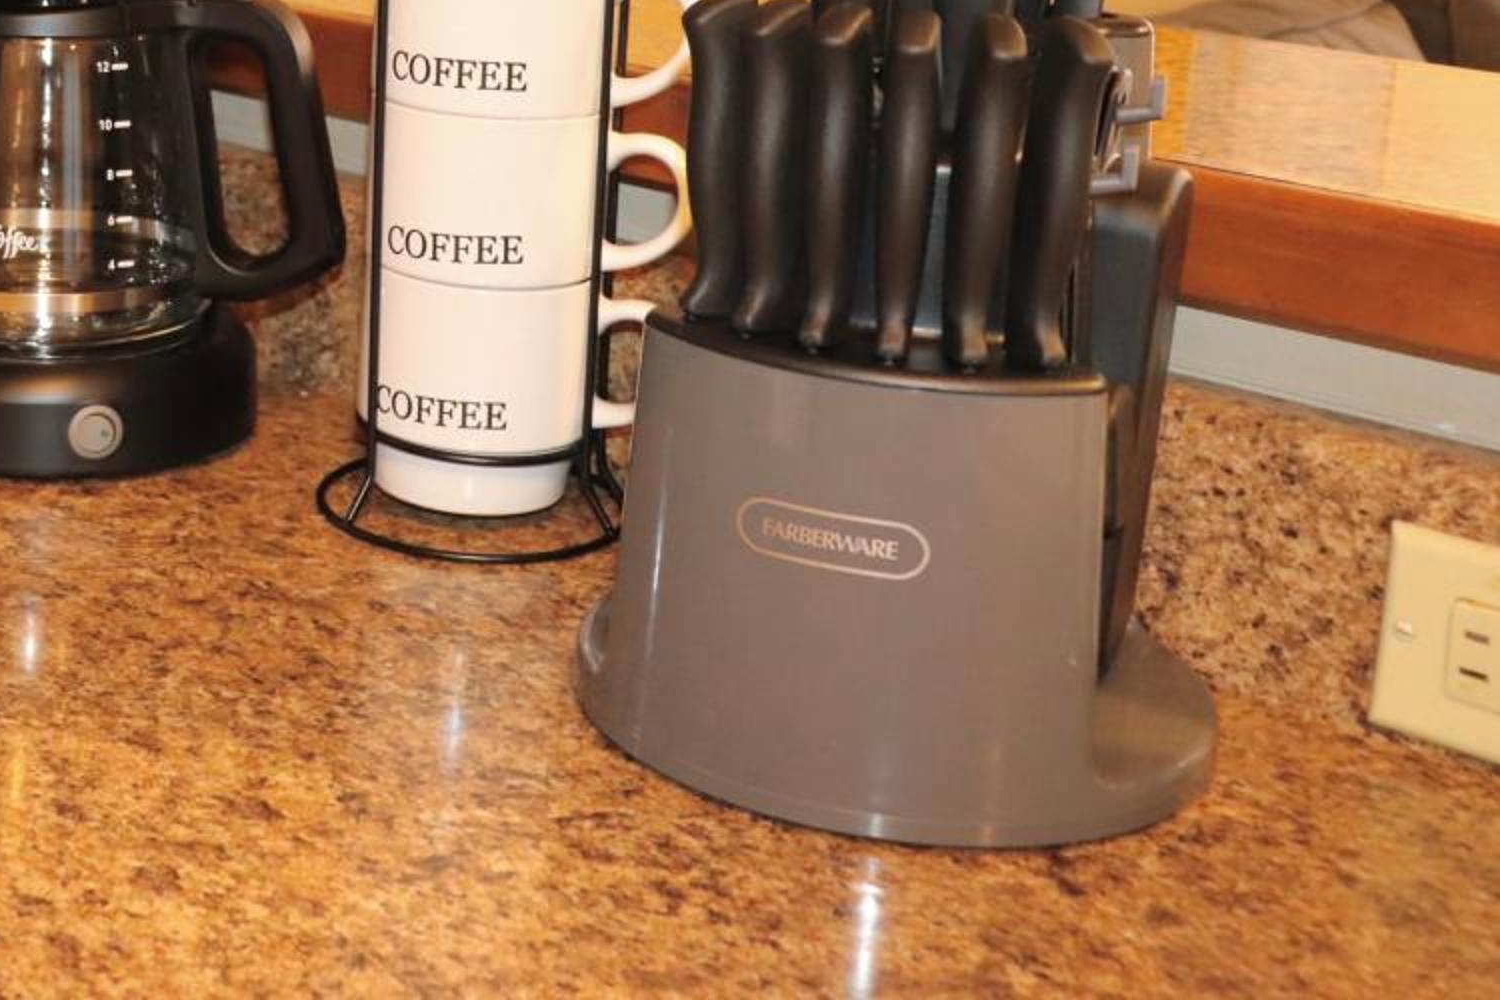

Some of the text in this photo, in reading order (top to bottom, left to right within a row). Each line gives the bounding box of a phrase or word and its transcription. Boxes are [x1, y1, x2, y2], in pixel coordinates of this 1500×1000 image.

[96, 60, 110, 73] 12
[392, 50, 528, 93] COFFEE
[99, 118, 112, 131] 10
[106, 168, 115, 181] 8
[387, 224, 524, 266] COFFEE
[107, 258, 116, 271] 4
[376, 384, 507, 430] COFFEE
[762, 516, 899, 563] FARBERWARE
